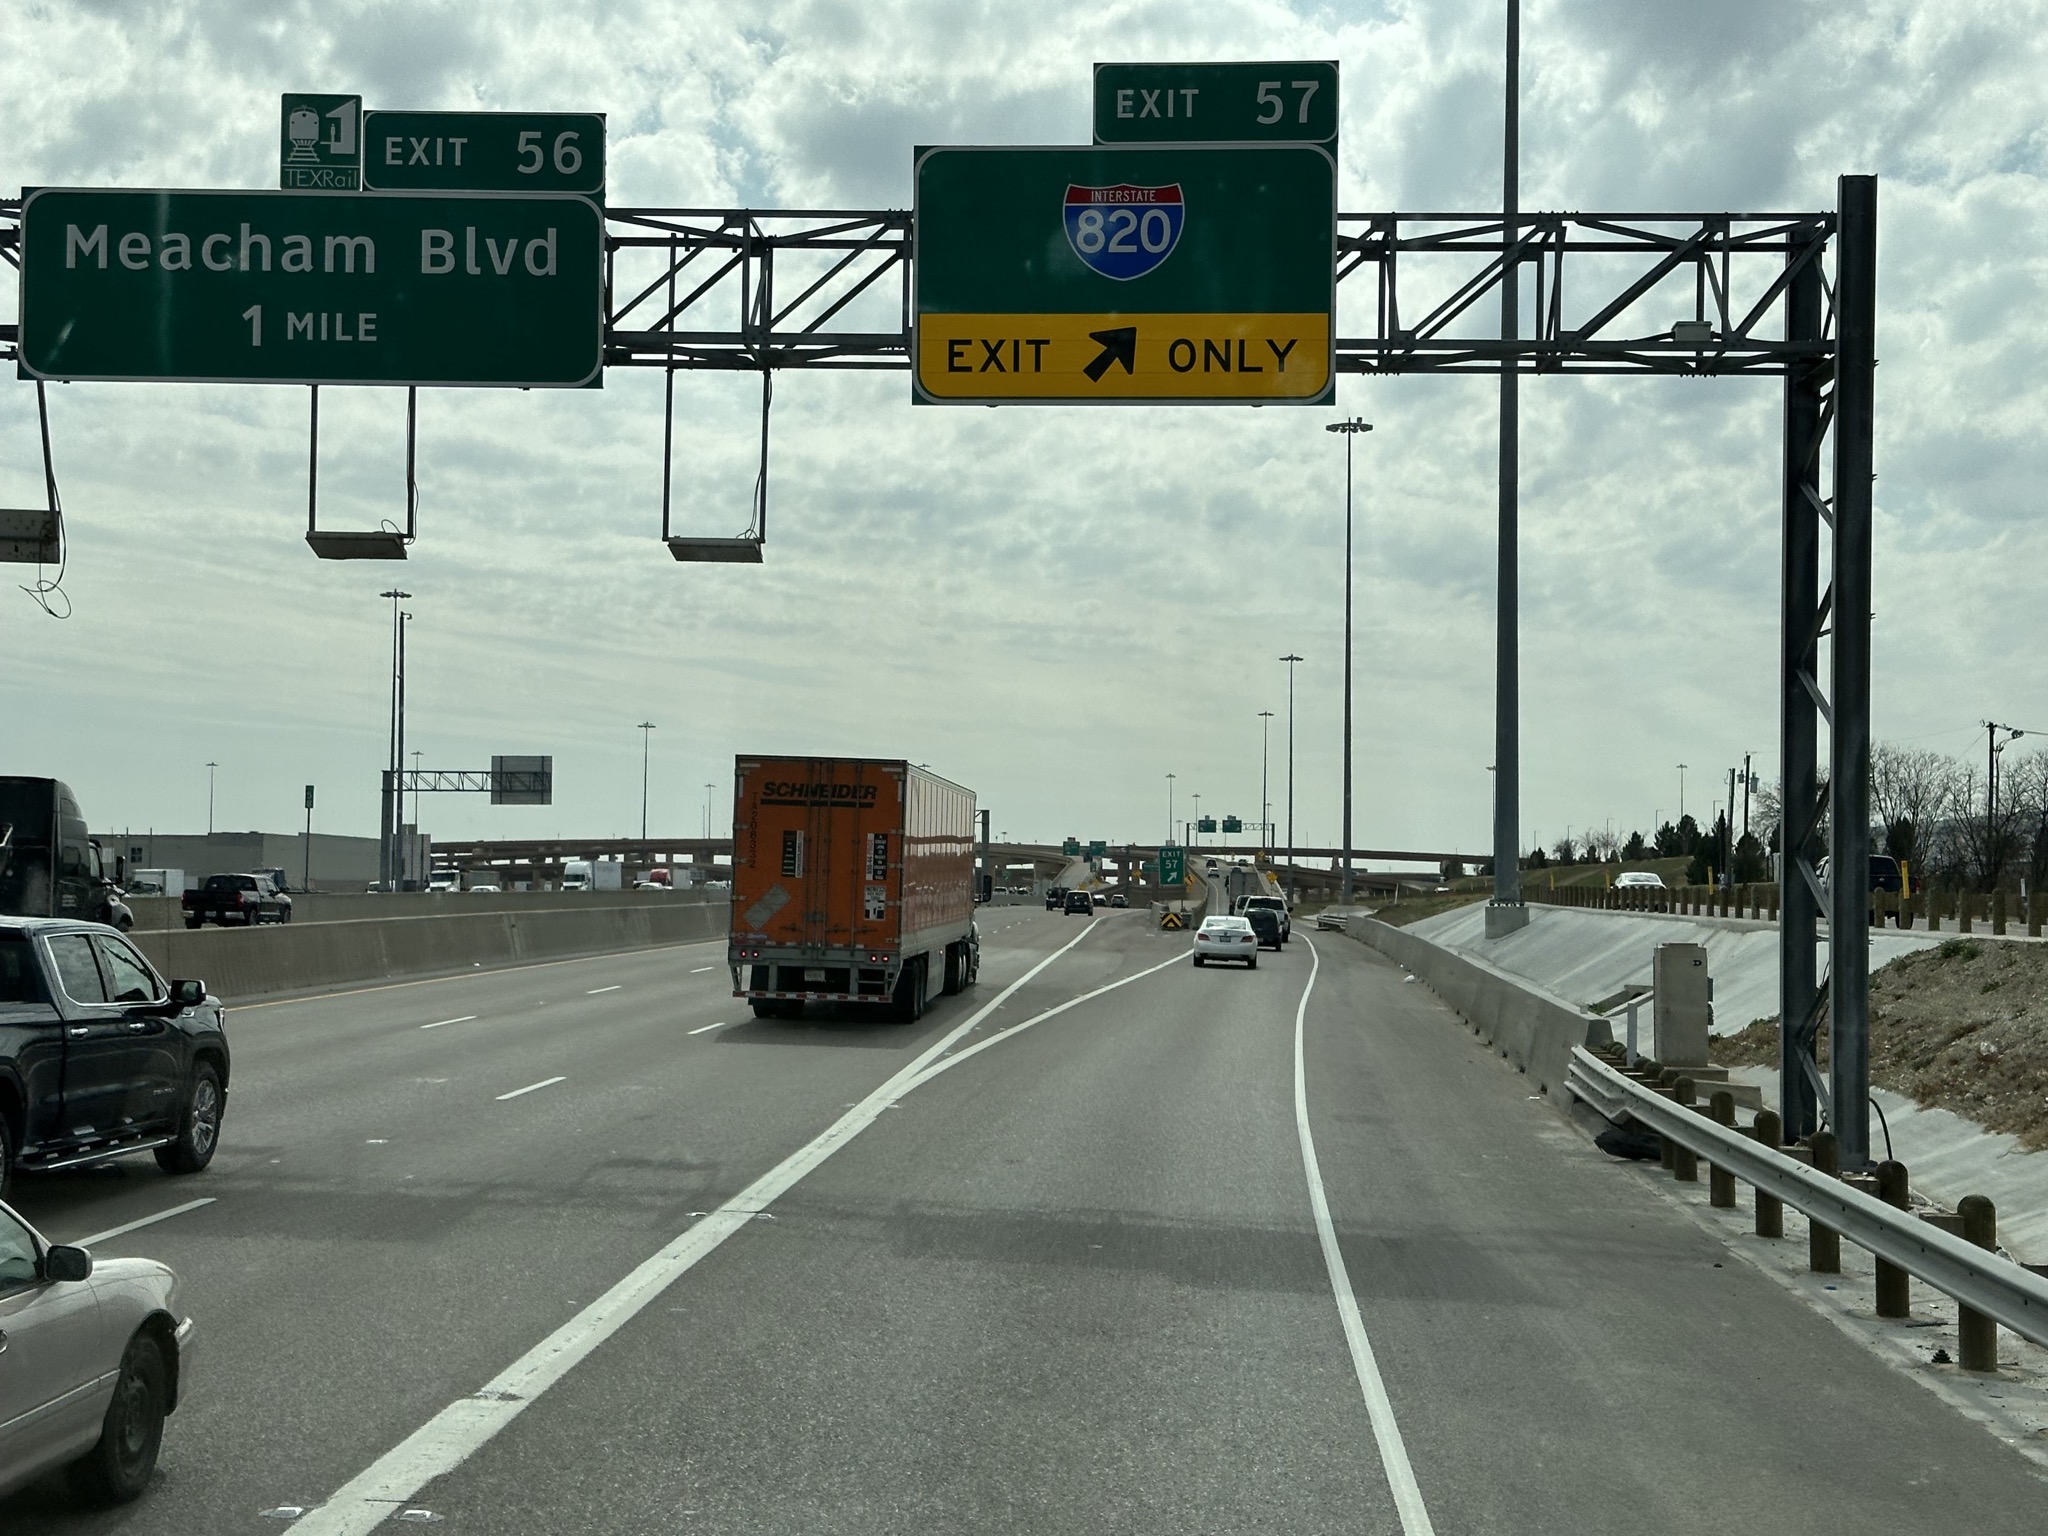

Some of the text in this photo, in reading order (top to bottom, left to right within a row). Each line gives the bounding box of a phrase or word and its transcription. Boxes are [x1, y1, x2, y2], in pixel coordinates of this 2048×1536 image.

[1117, 80, 1320, 125] EXIT 57
[385, 130, 583, 175] EXIT 56
[285, 168, 358, 189] TEXRail
[1090, 189, 1156, 203] INTERSTATE
[1075, 208, 1172, 255] 820
[65, 222, 557, 277] Meacham Blvd
[242, 304, 378, 347] 1 MILE
[947, 338, 1298, 373] EXIT ONLY
[763, 782, 878, 800] SCHNEIDER
[1161, 850, 1181, 858] EXIT
[1165, 859, 1178, 869] 57
